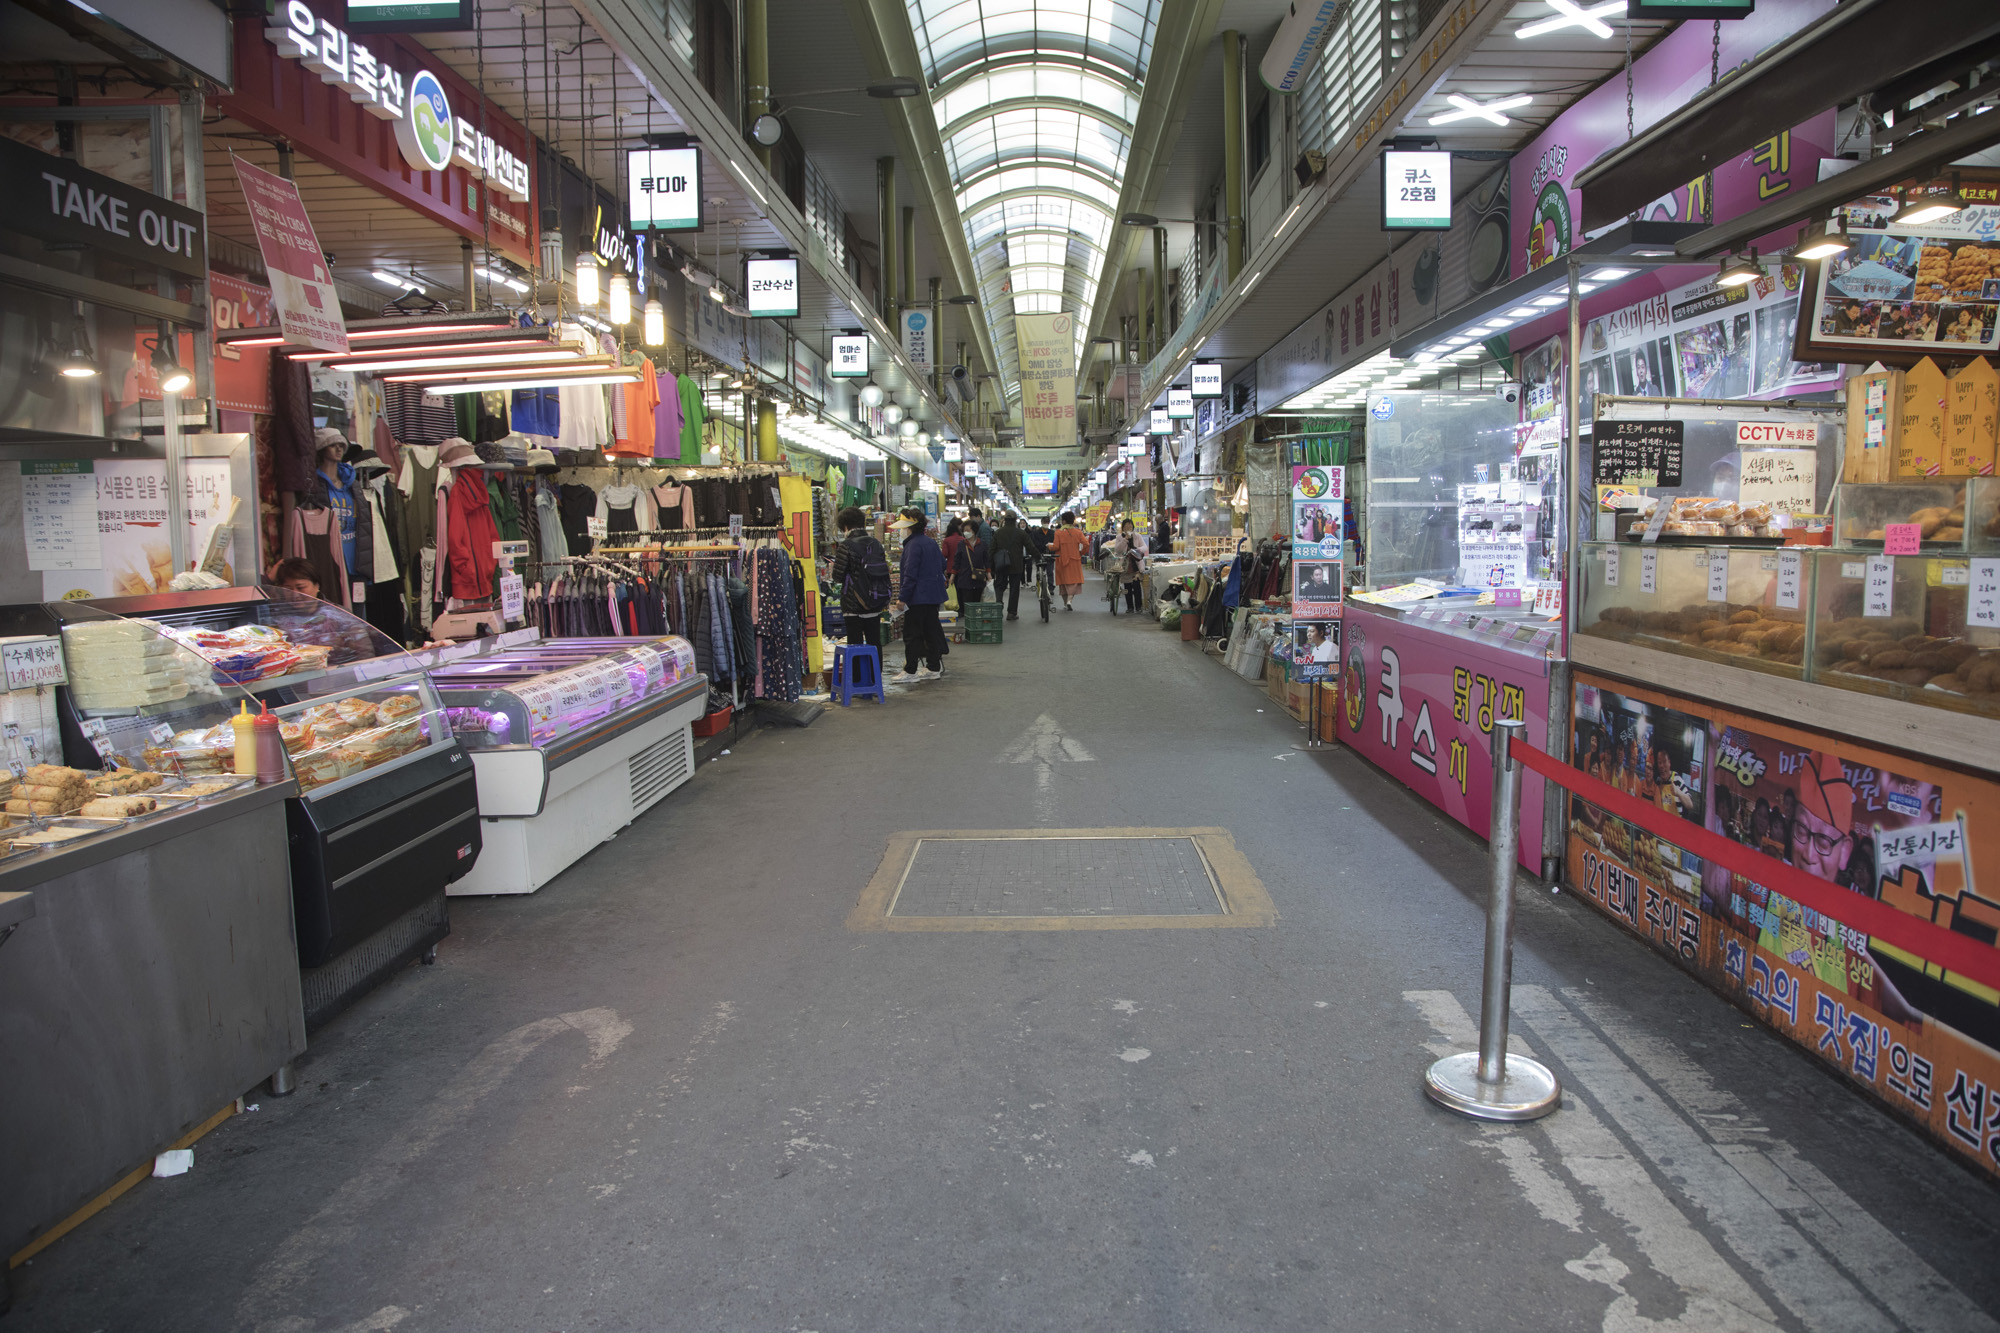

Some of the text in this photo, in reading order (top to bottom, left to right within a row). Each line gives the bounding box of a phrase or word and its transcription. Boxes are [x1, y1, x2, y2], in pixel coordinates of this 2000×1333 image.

[287, 0, 529, 202] 우리축산 도매센터
[1404, 169, 1432, 184] 큐스
[1531, 145, 1568, 197] 망원시장
[640, 176, 688, 194] 루디아
[1400, 186, 1436, 202] 2호점
[41, 171, 197, 258] TAKE OUT
[751, 279, 793, 291] 군산수산
[838, 345, 861, 354] 엄마손
[842, 354, 858, 364] 마트
[1955, 381, 1974, 394] HAPPY
[1374, 404, 1393, 414] ADT
[1953, 413, 1973, 426] HAPPY
[1617, 424, 1643, 434] 고로케
[1739, 425, 1816, 441] CCTV 녹화중
[1624, 439, 1639, 448] 500
[1624, 449, 1638, 458] 500
[1950, 447, 1967, 457] HAPPY
[1624, 459, 1638, 467] 500
[103, 475, 134, 500] 식품은
[136, 475, 157, 500] 믿을
[123, 509, 148, 520] 위생적인
[148, 509, 168, 520] 안전한
[1295, 655, 1315, 666] tvN
[1377, 645, 1437, 777] 큐스
[1732, 731, 1750, 748] KBS
[1898, 783, 1918, 796] KBS
[1881, 828, 1961, 859] 전통시장
[1581, 850, 1640, 928] 121번째
[1643, 885, 1700, 963] 주인공
[1802, 905, 1868, 957] 121번째 주인공
[1814, 936, 1847, 974] 김영호
[1849, 955, 1875, 992] 상인
